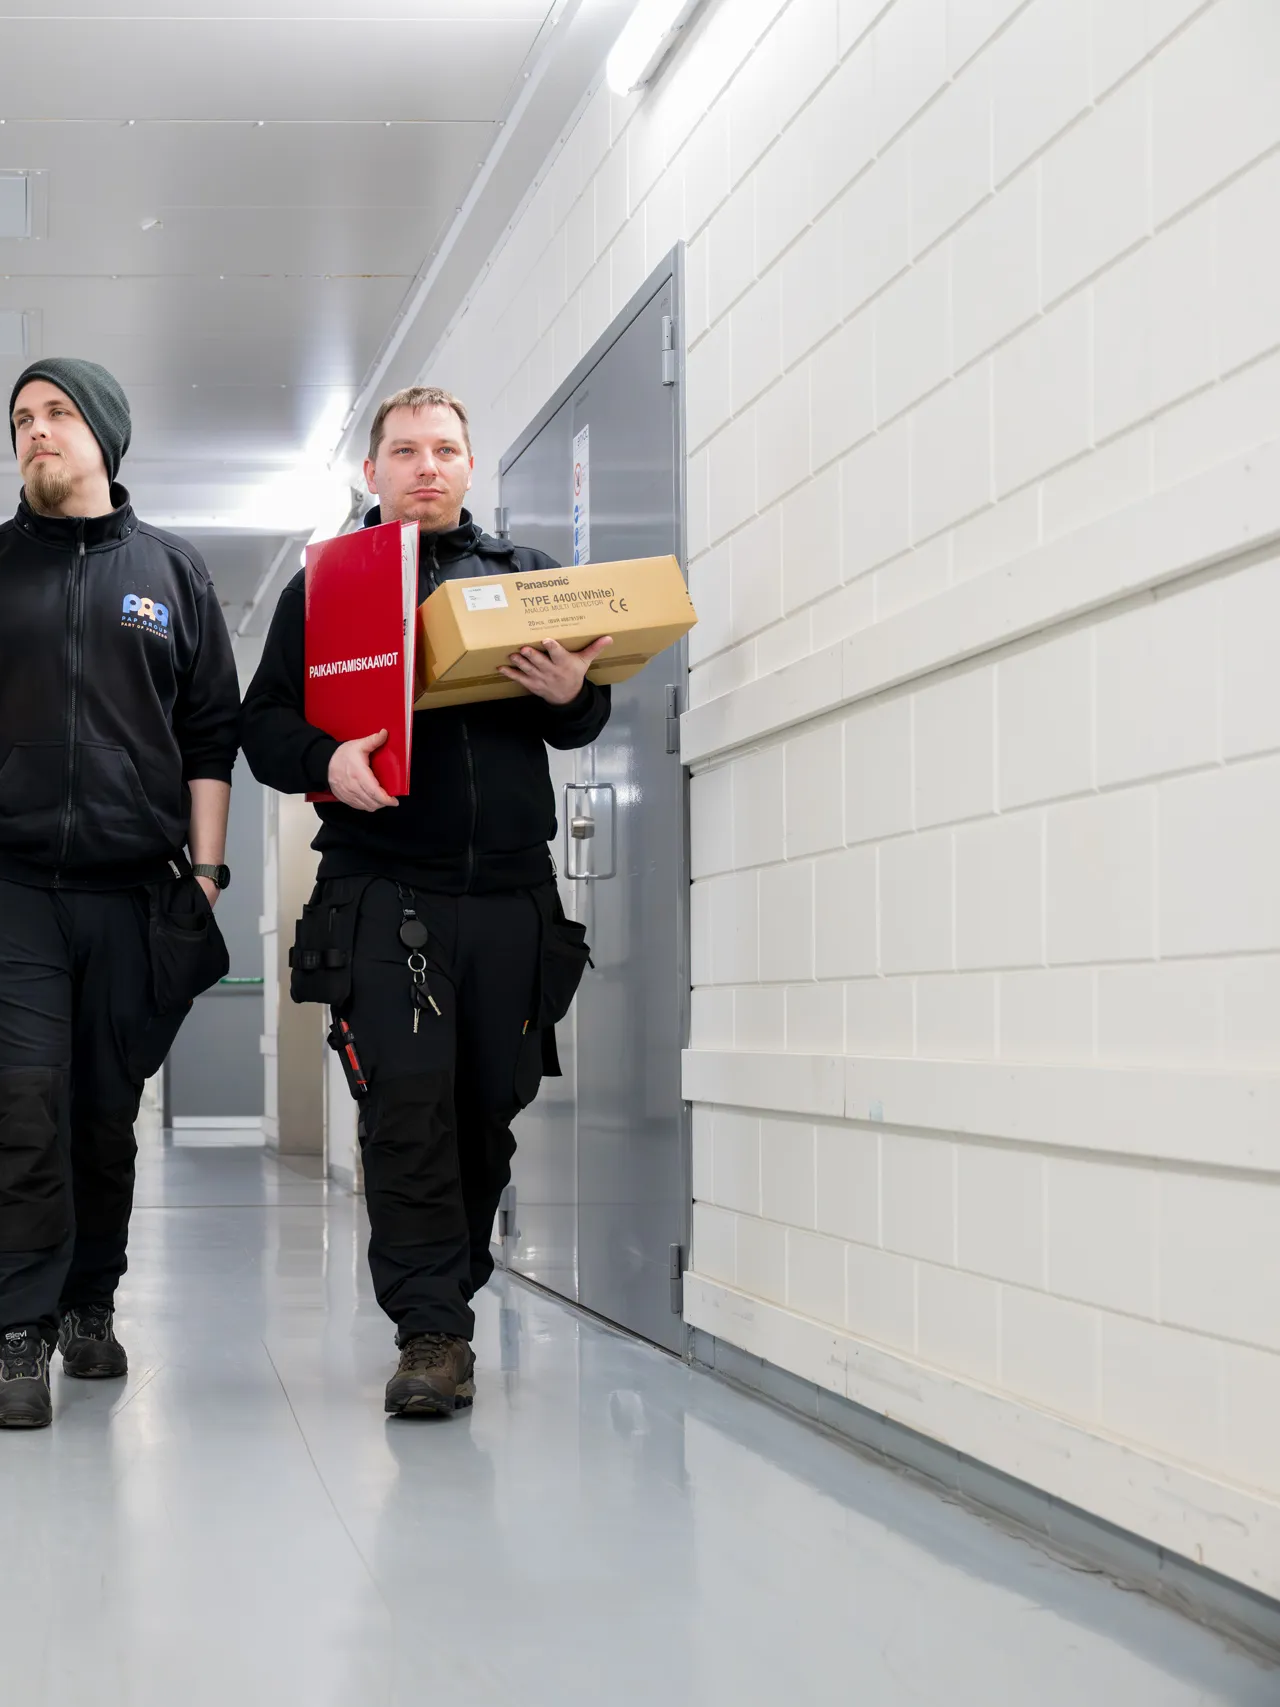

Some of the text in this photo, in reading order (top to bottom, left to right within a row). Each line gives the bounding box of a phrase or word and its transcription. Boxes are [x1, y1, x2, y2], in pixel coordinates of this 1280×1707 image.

[515, 576, 570, 591] Panasonic
[521, 595, 550, 607] TYPE
[524, 606, 549, 614] ANALOG
[572, 600, 603, 608] DETECTOR
[121, 615, 168, 634] PAP GROUP
[309, 652, 398, 678] PAIKANTAMISKAAVIOT
